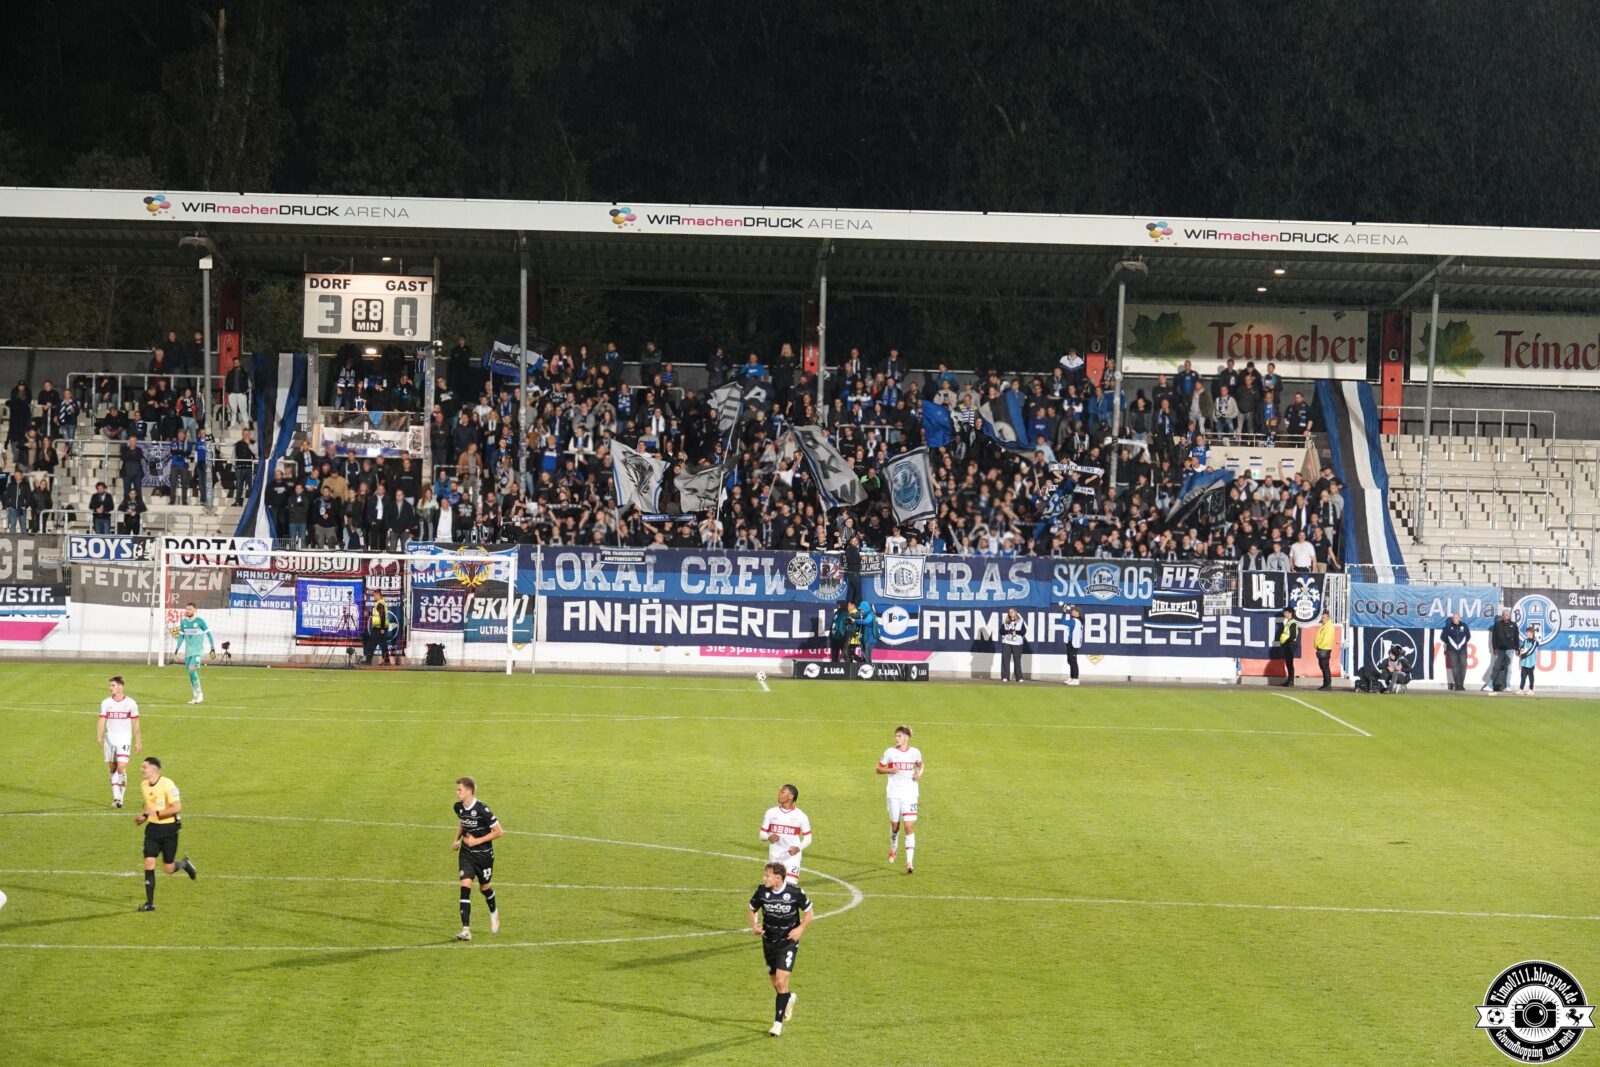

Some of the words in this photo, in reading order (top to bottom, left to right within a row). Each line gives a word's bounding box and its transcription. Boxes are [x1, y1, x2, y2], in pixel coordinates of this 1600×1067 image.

[182, 201, 339, 217] WIRmachenDRUCK
[344, 206, 409, 218] ARENA
[647, 213, 803, 229] WIRmachenDRUCK
[808, 218, 873, 230] ARENA
[1184, 228, 1340, 244] WIRmachenDRUCK
[1344, 233, 1409, 246] ARENA
[309, 277, 352, 290] DORF
[385, 280, 428, 292] GAST
[317, 294, 343, 334] 3
[353, 299, 381, 320] 88
[393, 296, 418, 336] 0
[355, 321, 379, 332] MIN
[1494, 330, 1600, 371] Teinac
[70, 537, 132, 561] BOYS
[165, 538, 239, 566] PORTA
[0, 537, 35, 580] GE
[236, 570, 292, 581] HANNOVER
[530, 552, 665, 592] LOKAL
[680, 556, 787, 596] CREW
[1052, 563, 1086, 598] SK
[1123, 566, 1153, 600] 05
[1161, 566, 1200, 590] 647
[0, 585, 55, 604] ESTF.
[122, 591, 142, 603] ON
[308, 585, 354, 602] BLUE
[233, 600, 259, 608] MELLE
[260, 600, 291, 609] MINDEN
[1151, 599, 1198, 615] BIELEFELD
[1354, 598, 1408, 620] copa
[1416, 597, 1495, 618] cALMa
[419, 606, 463, 624] 1905
[563, 598, 838, 641] ANHÄNGERCLU
[479, 625, 510, 635] ULTRAS
[830, 667, 845, 675] LIGA
